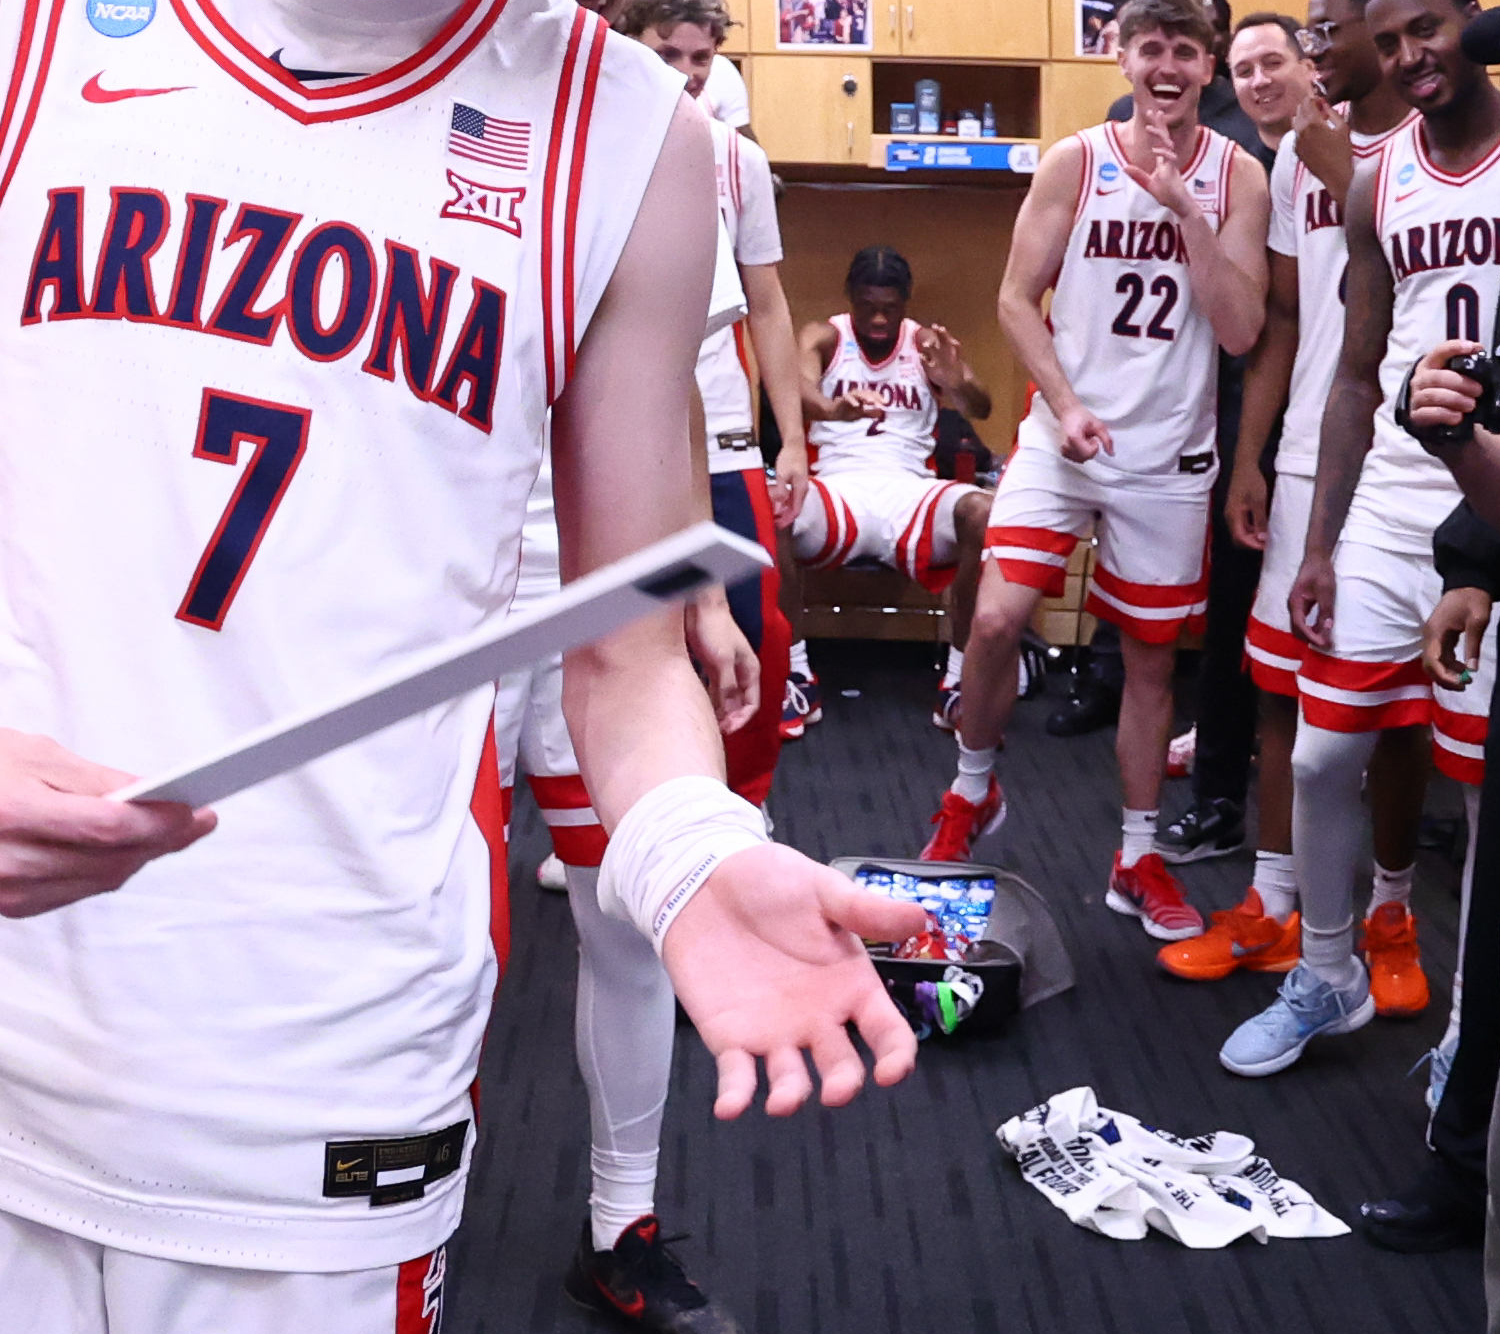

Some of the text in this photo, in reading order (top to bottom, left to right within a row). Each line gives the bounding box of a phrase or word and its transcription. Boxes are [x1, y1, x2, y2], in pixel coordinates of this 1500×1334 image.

[94, 2, 151, 23] NCAA
[452, 177, 520, 233] XII
[1083, 219, 1191, 267] ARIZON
[19, 186, 508, 436] ARIZONA
[1111, 272, 1179, 341] 22
[175, 386, 313, 632] 7
